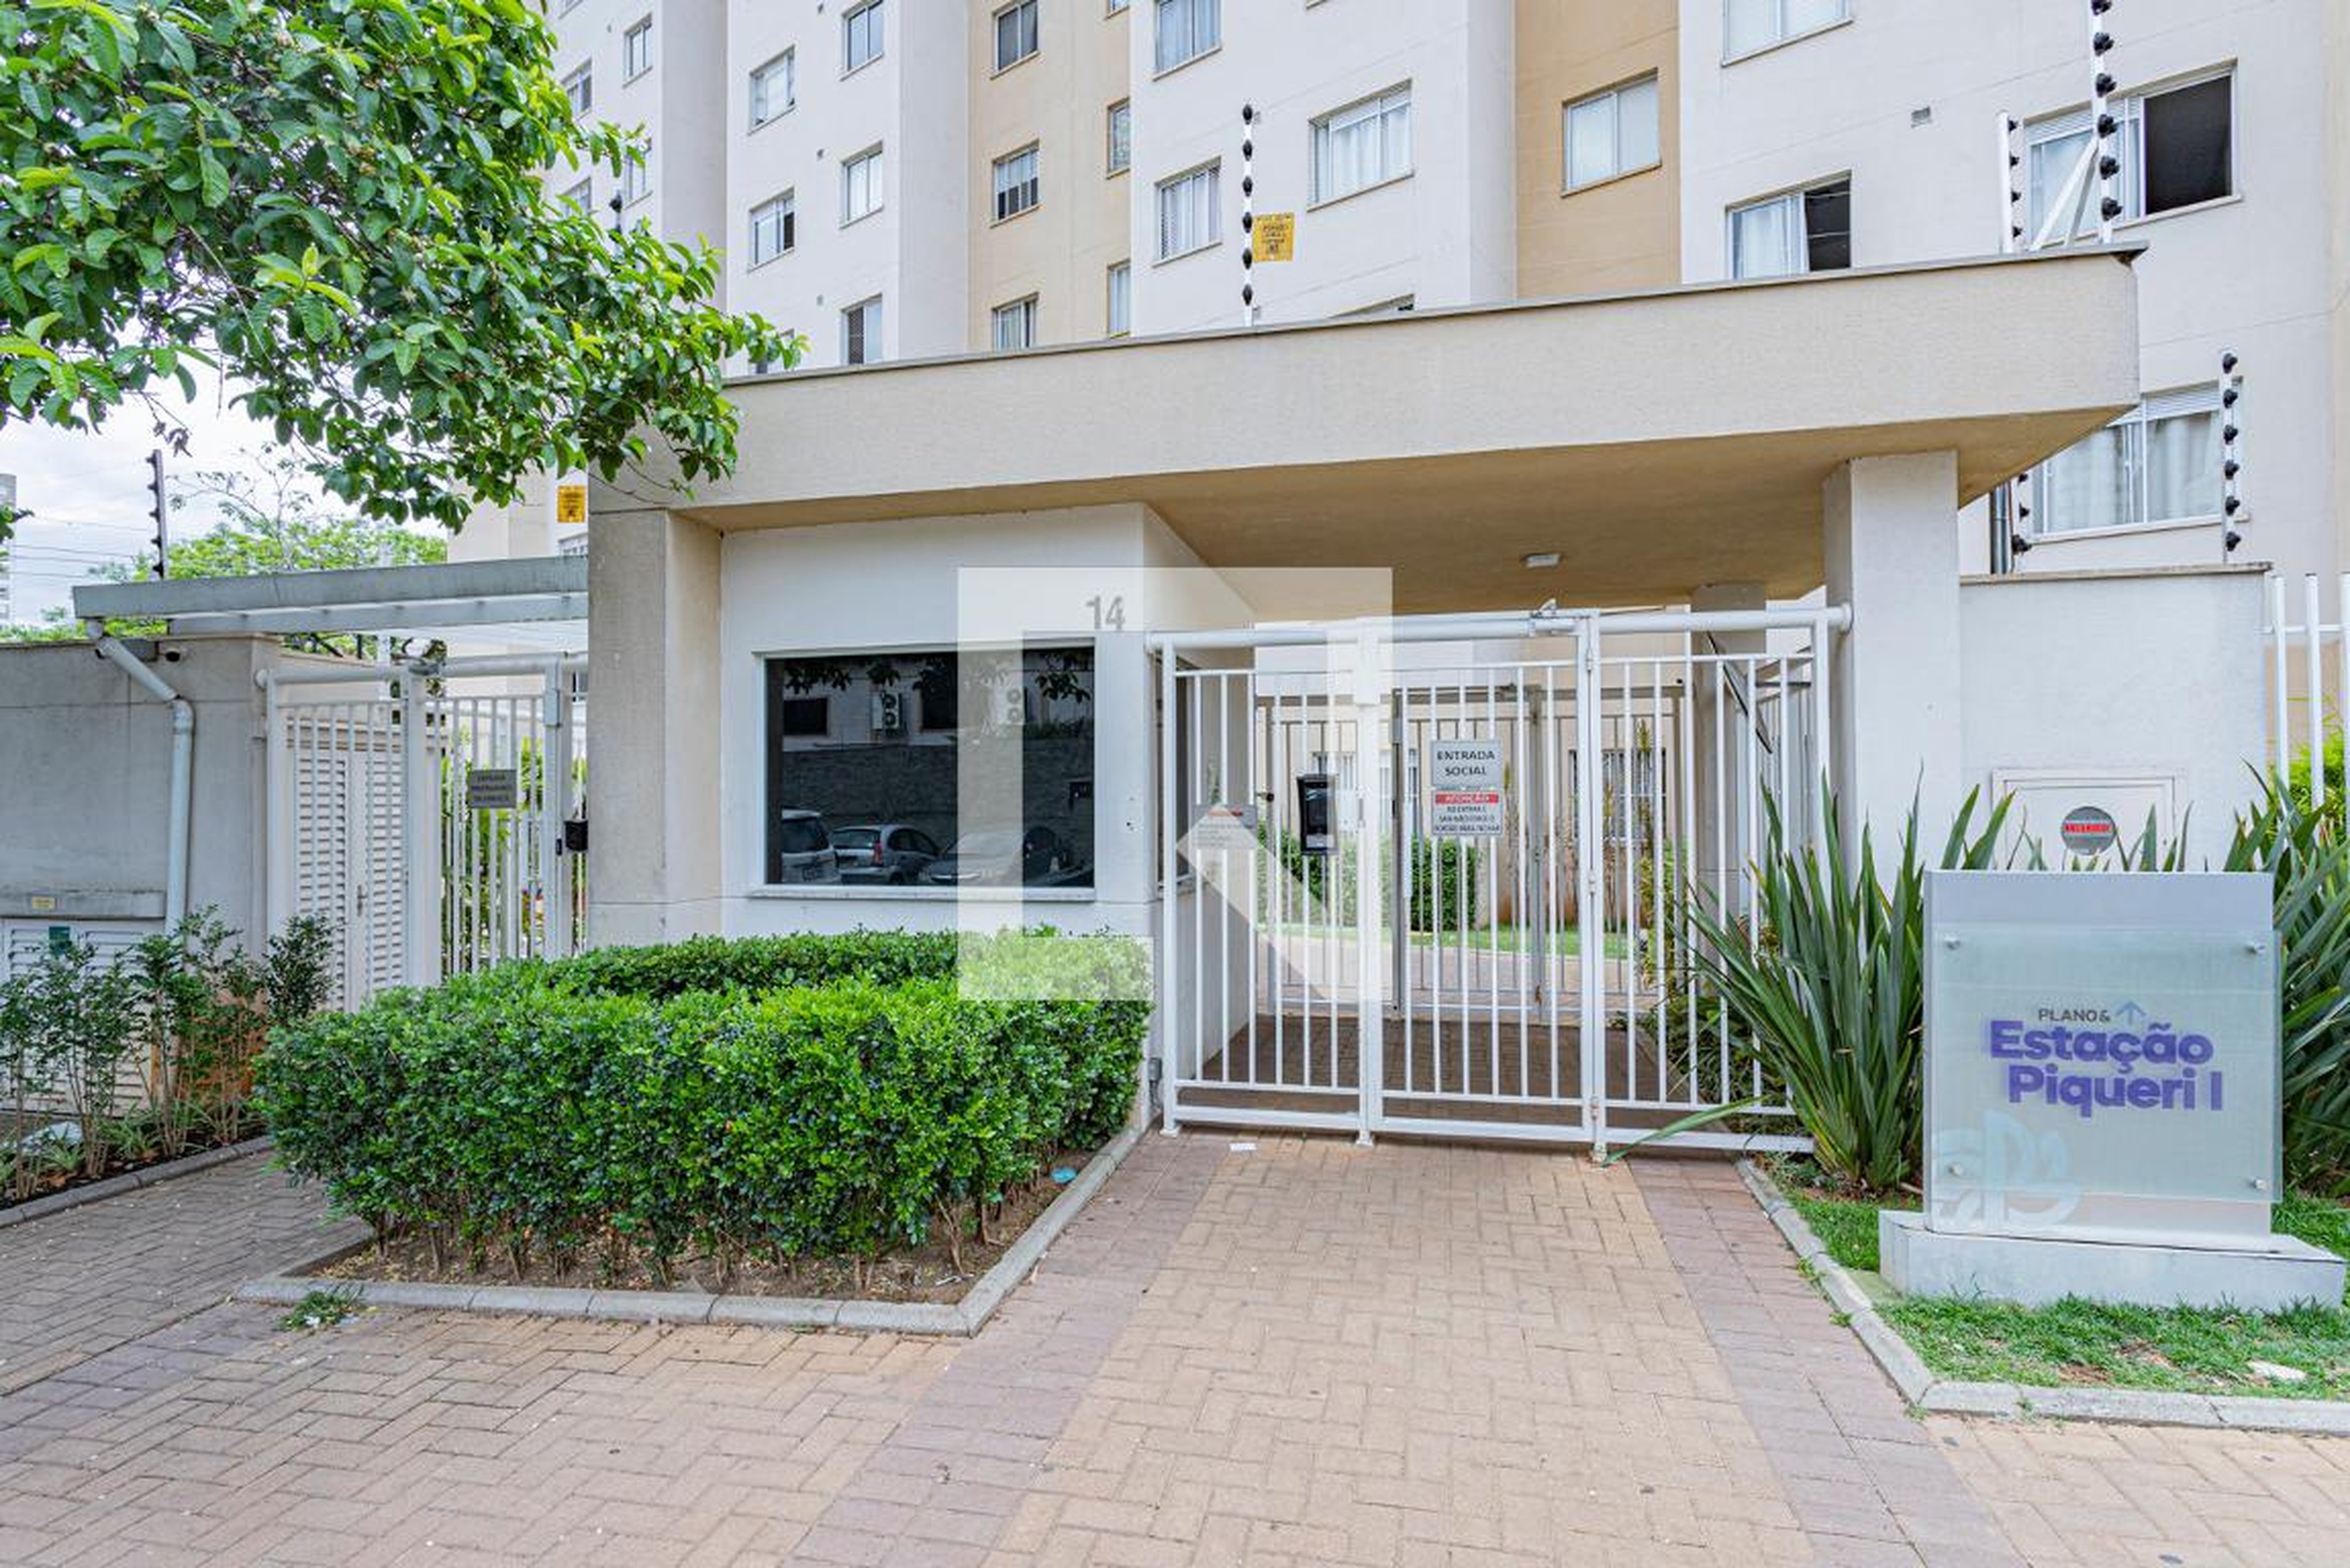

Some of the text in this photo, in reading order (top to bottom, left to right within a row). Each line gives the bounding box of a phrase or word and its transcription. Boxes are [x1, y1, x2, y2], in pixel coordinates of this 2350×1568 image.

[1086, 595, 1125, 630] 14
[1437, 750, 1495, 760] ENTRADA
[1445, 766, 1487, 776] SOCIAL
[2039, 1008, 2111, 1023] PLANO&
[1990, 1020, 2214, 1074] Estação
[2009, 1063, 2223, 1118] Piqueri I
